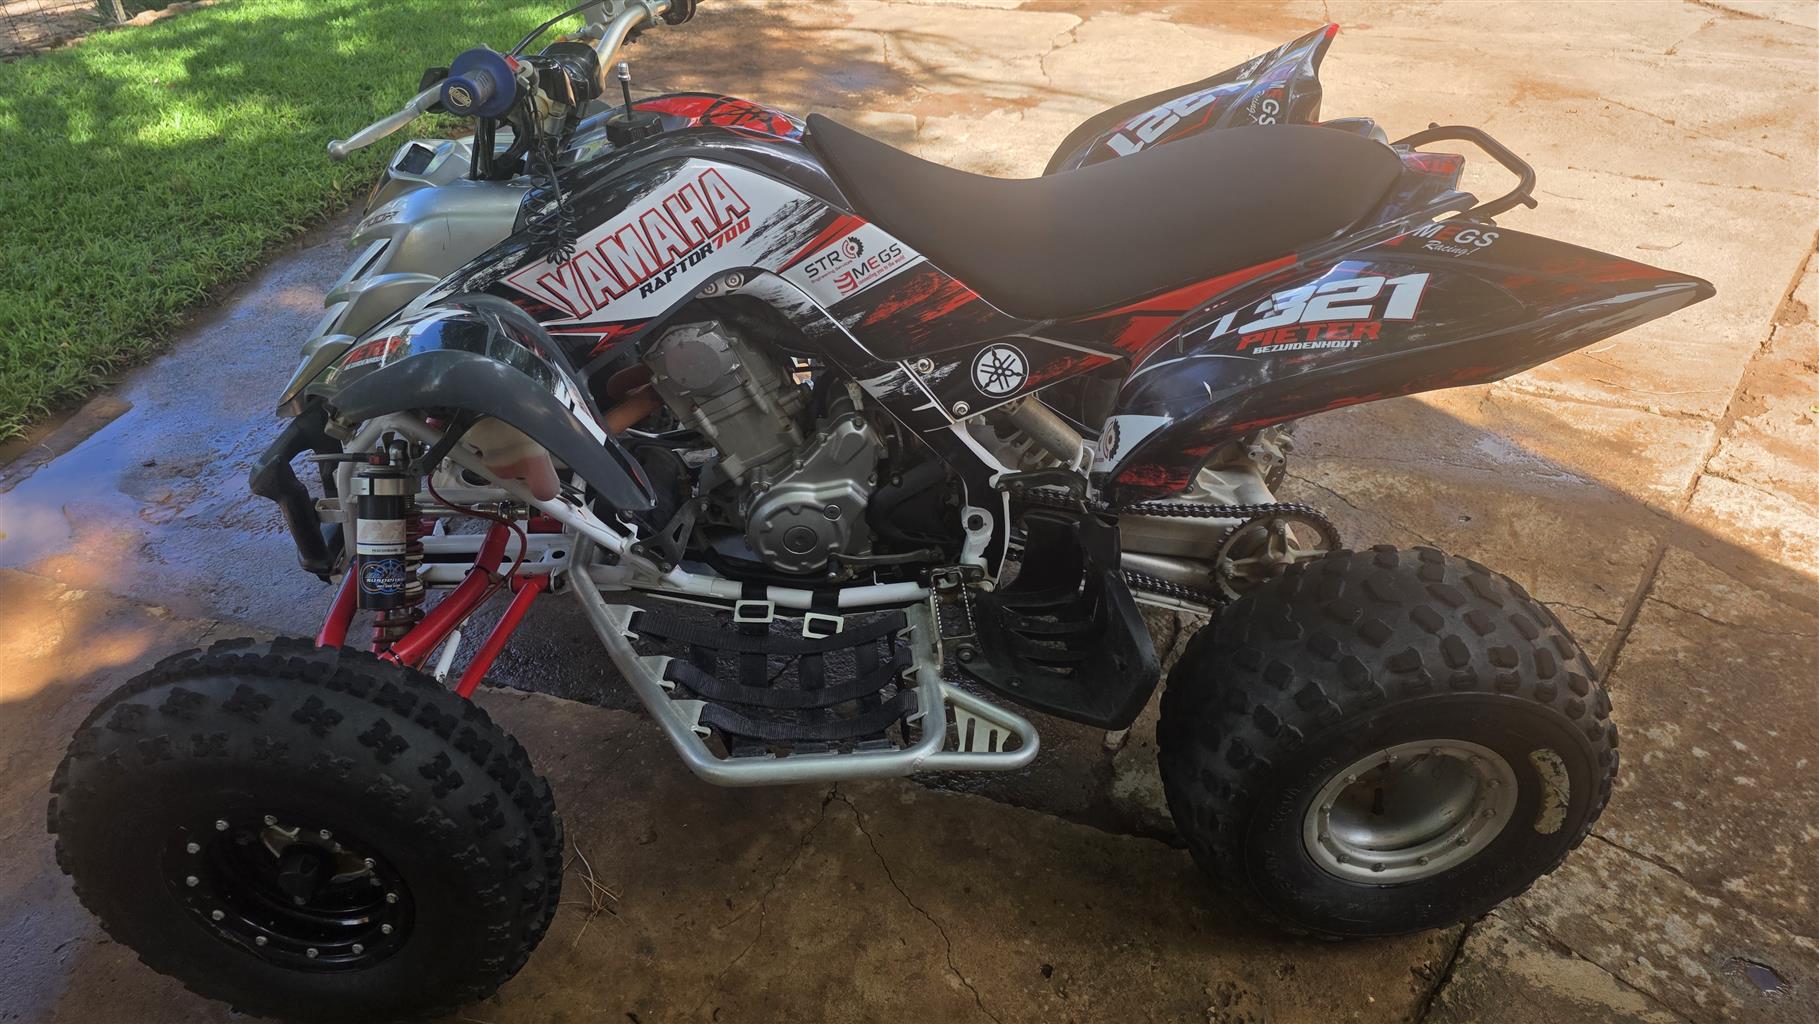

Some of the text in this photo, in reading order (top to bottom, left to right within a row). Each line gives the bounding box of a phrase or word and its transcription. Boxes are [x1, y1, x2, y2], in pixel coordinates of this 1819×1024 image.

[537, 167, 751, 319] YAMAHA
[1412, 223, 1500, 247] MEGS
[1422, 239, 1481, 257] Racing!
[852, 243, 902, 279] MEGS
[1238, 272, 1430, 334] 321
[1236, 321, 1382, 350] PIETER
[1253, 340, 1361, 354] BEZUIDENHOUT
